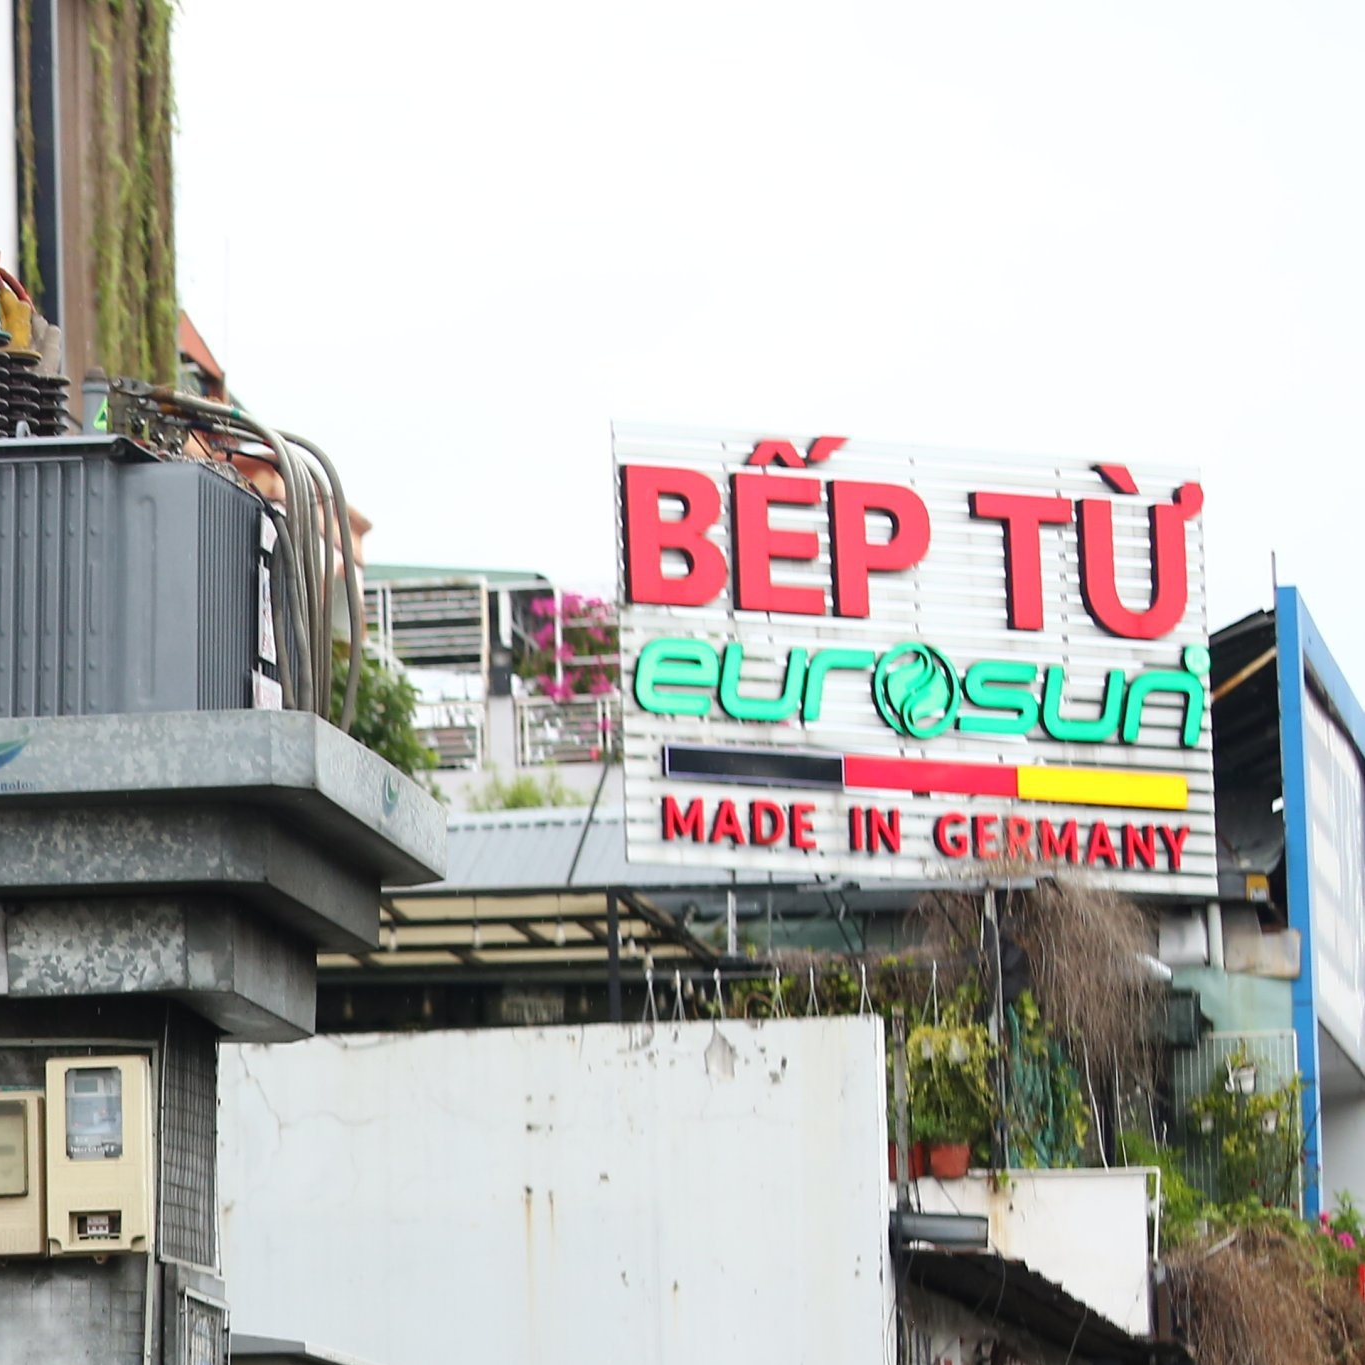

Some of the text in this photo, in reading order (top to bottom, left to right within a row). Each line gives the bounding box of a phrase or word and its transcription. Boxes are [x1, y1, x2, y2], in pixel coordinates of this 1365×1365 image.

[621, 436, 1205, 640] BẾP TỪ
[662, 794, 1190, 871] MADE IN GERMANY
